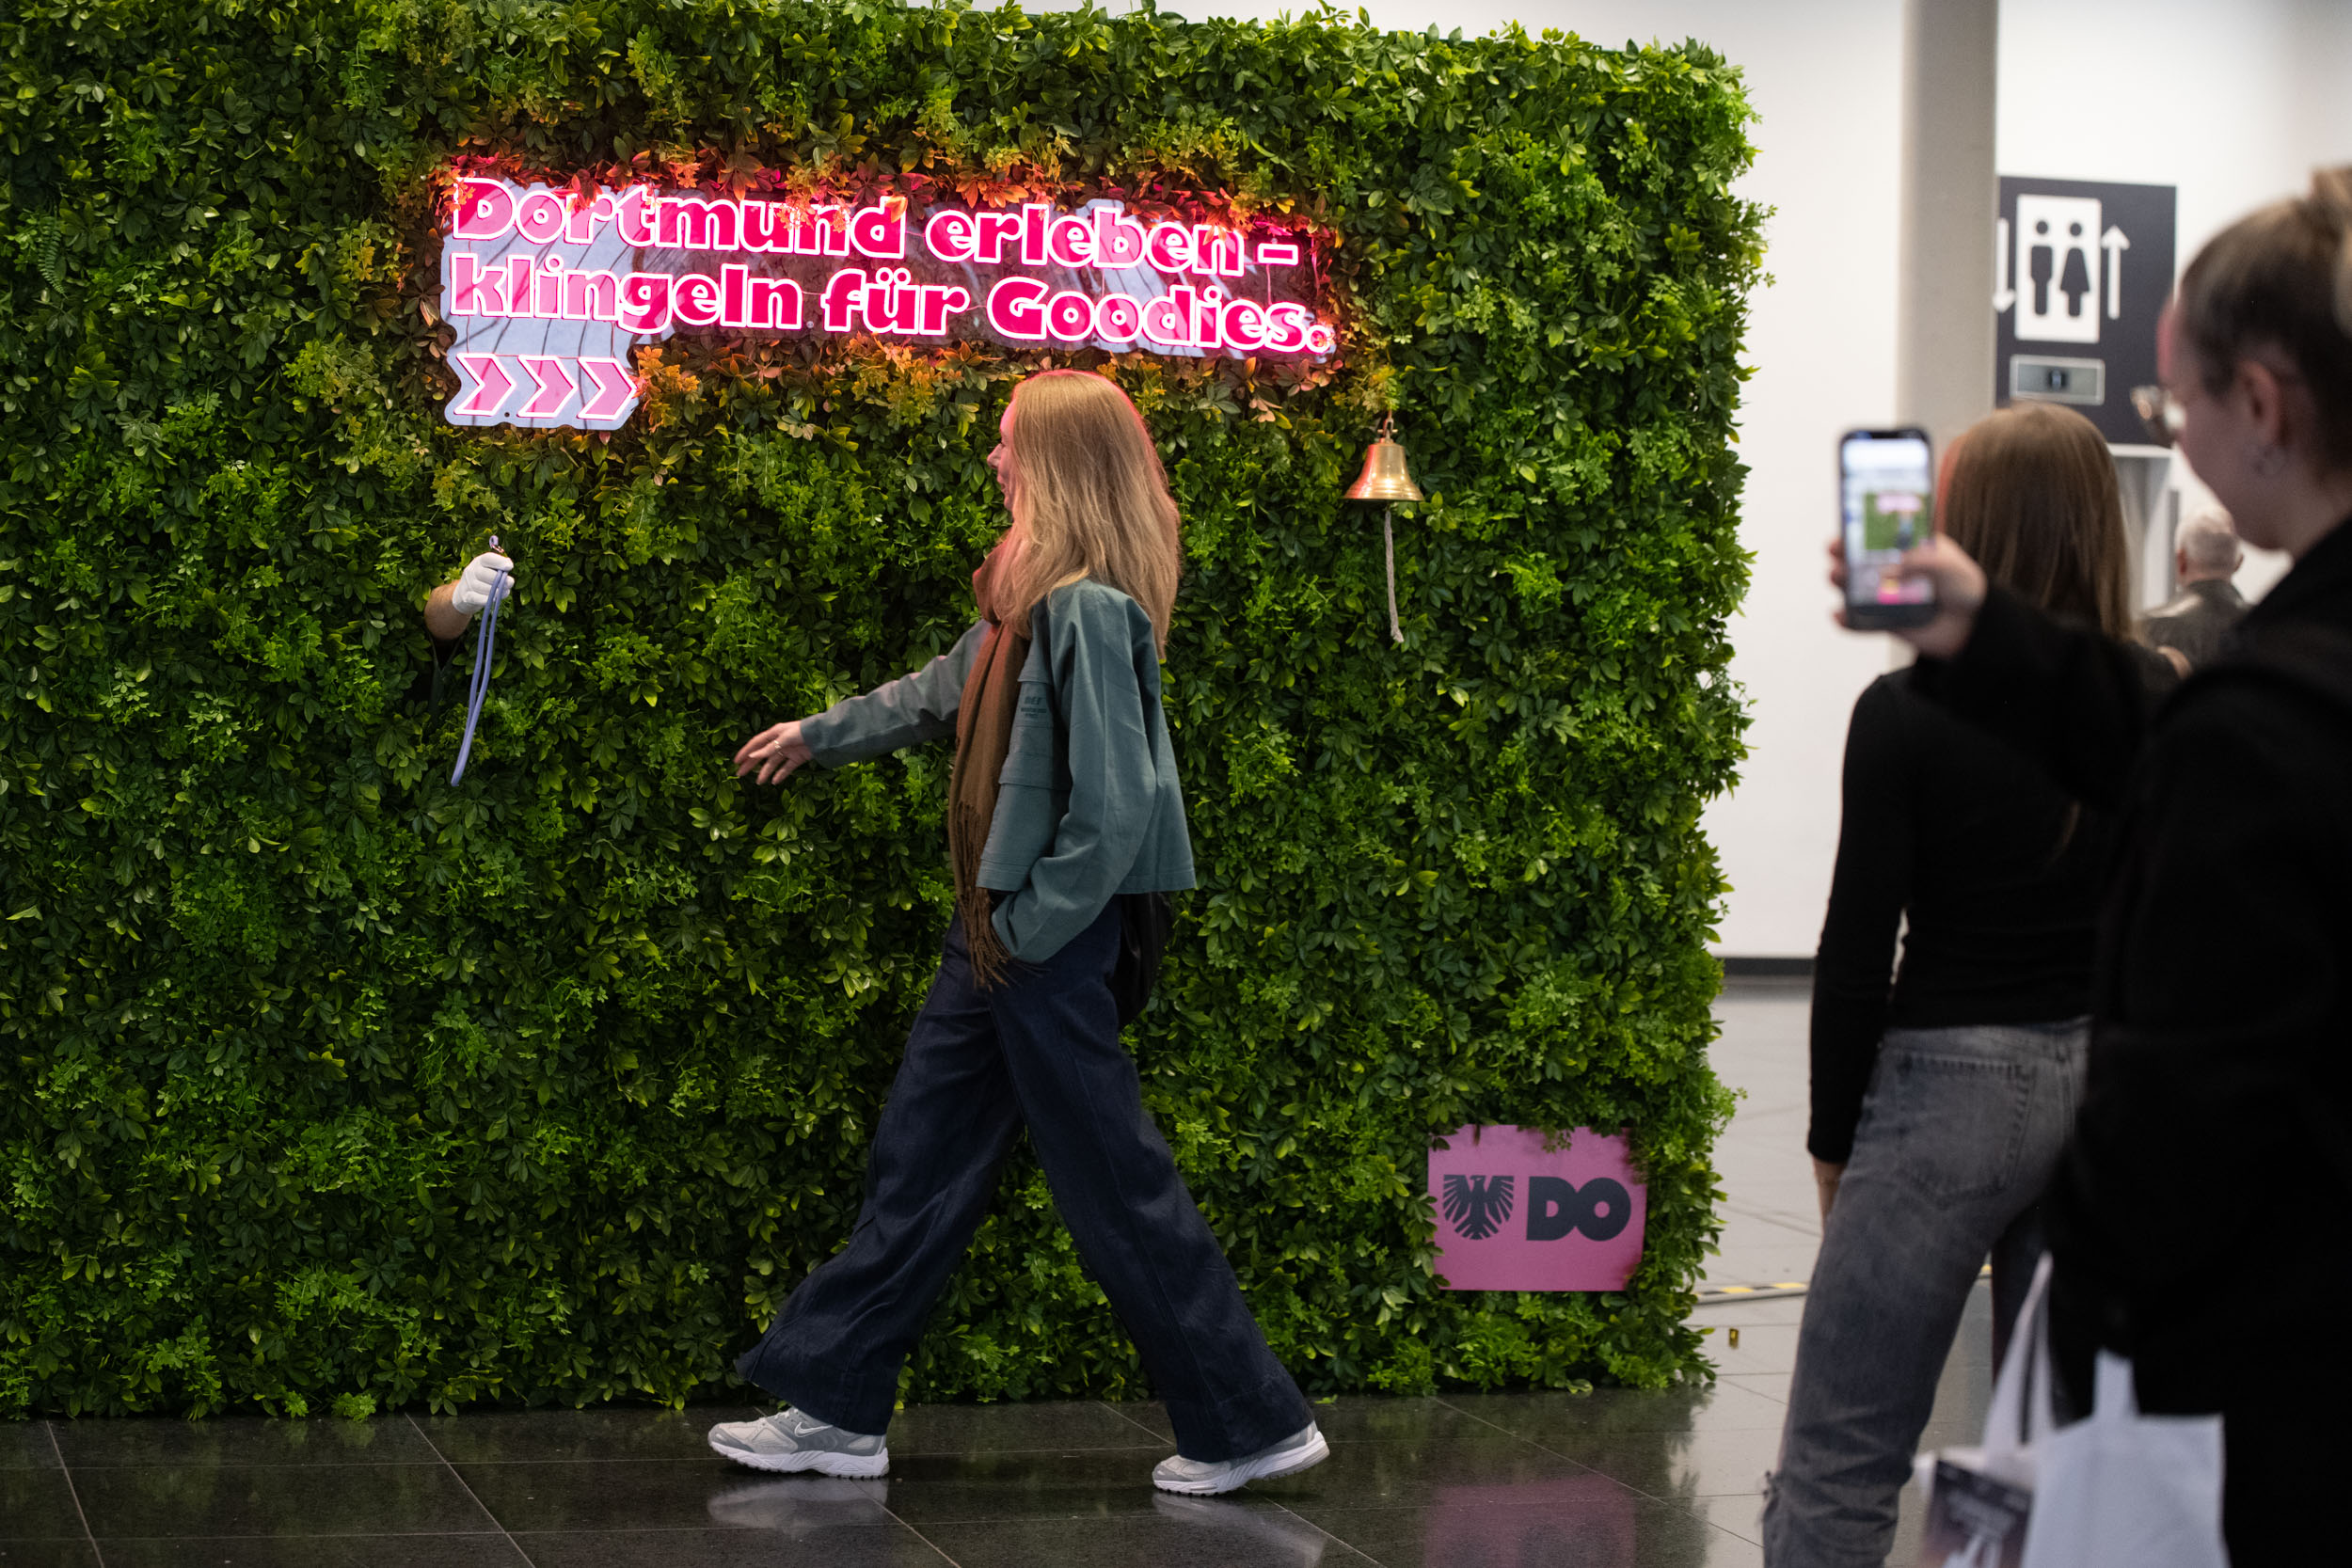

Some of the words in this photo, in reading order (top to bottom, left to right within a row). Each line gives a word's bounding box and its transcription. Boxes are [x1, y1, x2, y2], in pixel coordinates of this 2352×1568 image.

[453, 177, 907, 259] Dortmund
[925, 202, 1245, 277] erleben
[450, 252, 803, 334] klingeln
[820, 267, 971, 335] für
[987, 276, 1331, 354] Goodies.
[1526, 1176, 1631, 1242] DO
